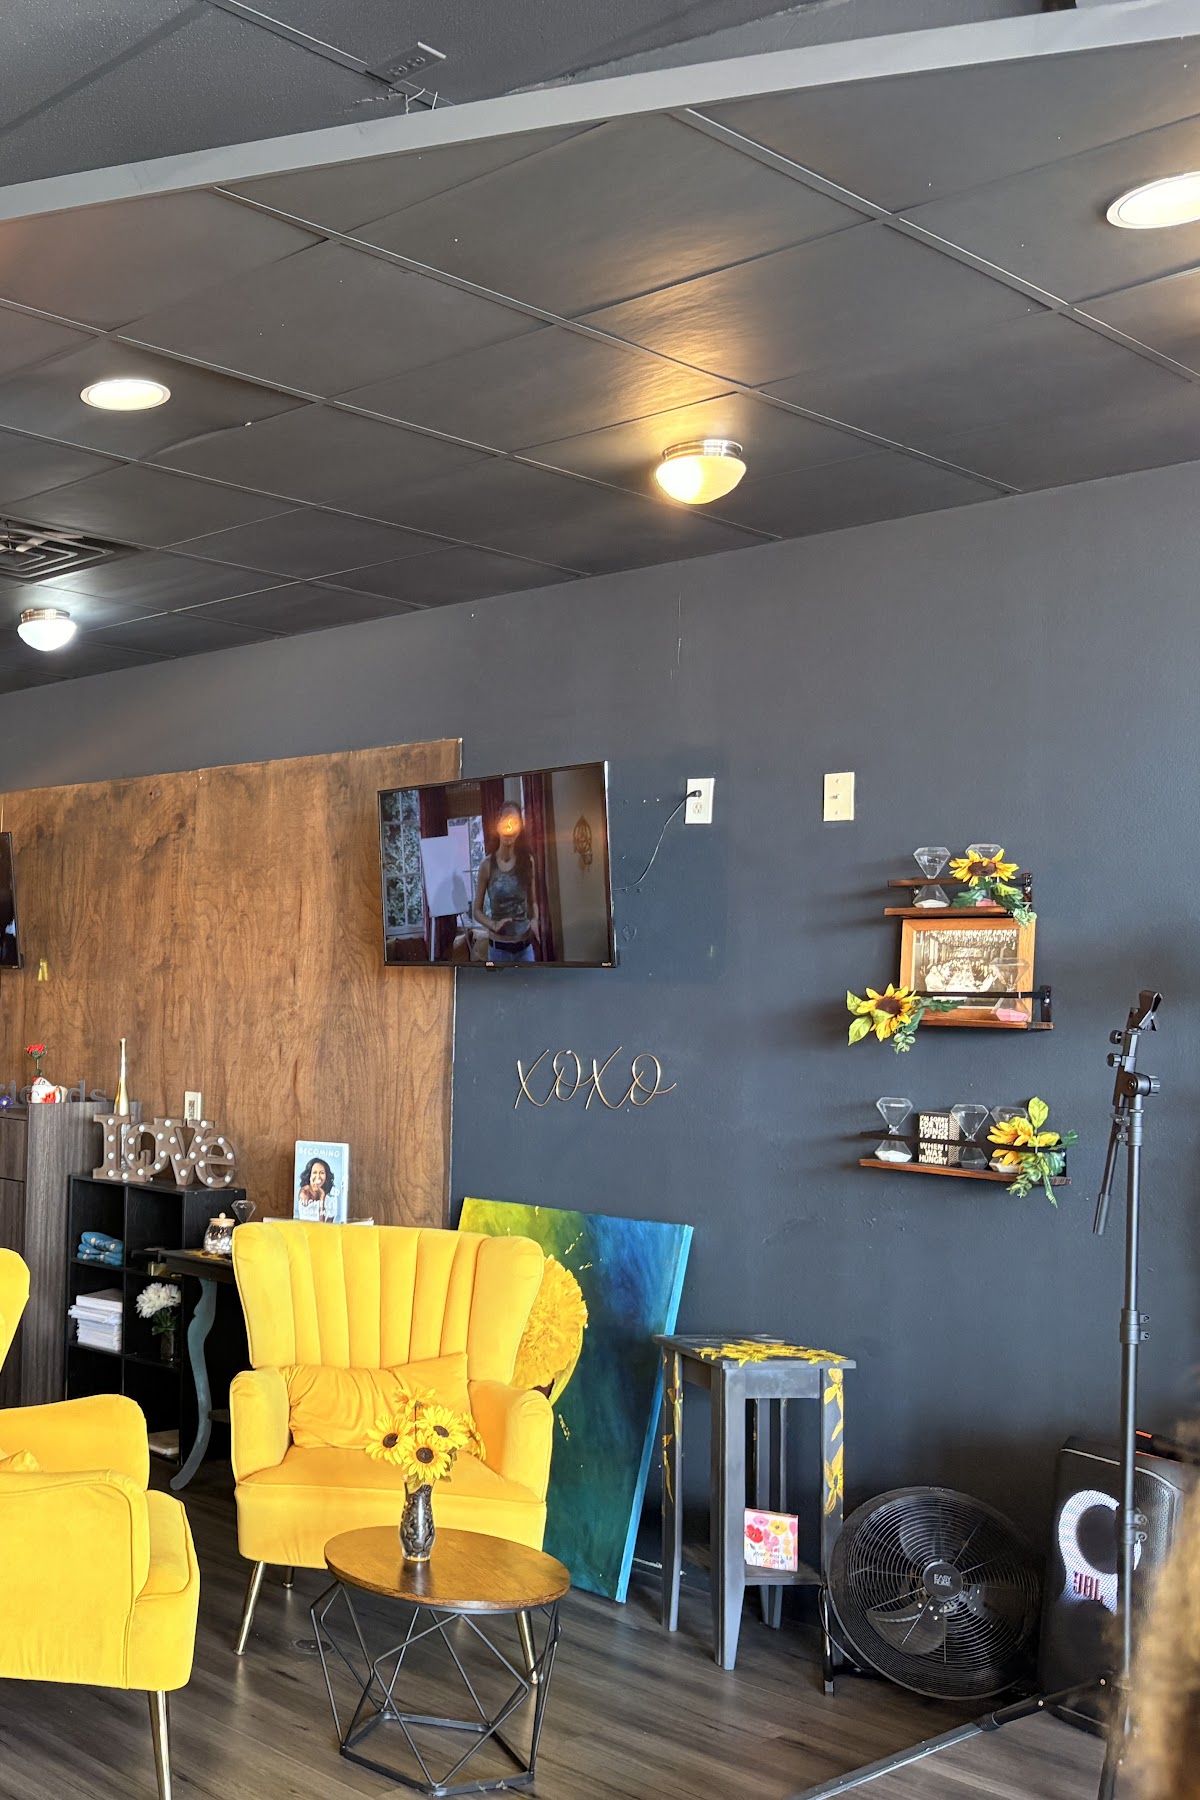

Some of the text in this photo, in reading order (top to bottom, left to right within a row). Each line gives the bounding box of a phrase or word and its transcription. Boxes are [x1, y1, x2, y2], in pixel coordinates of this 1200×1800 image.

[935, 1121, 948, 1129] THE
[919, 1142, 944, 1151] WHEN
[299, 1147, 341, 1159] BECOMING
[924, 1149, 943, 1157] WAS
[919, 1154, 947, 1165] HUNGRY
